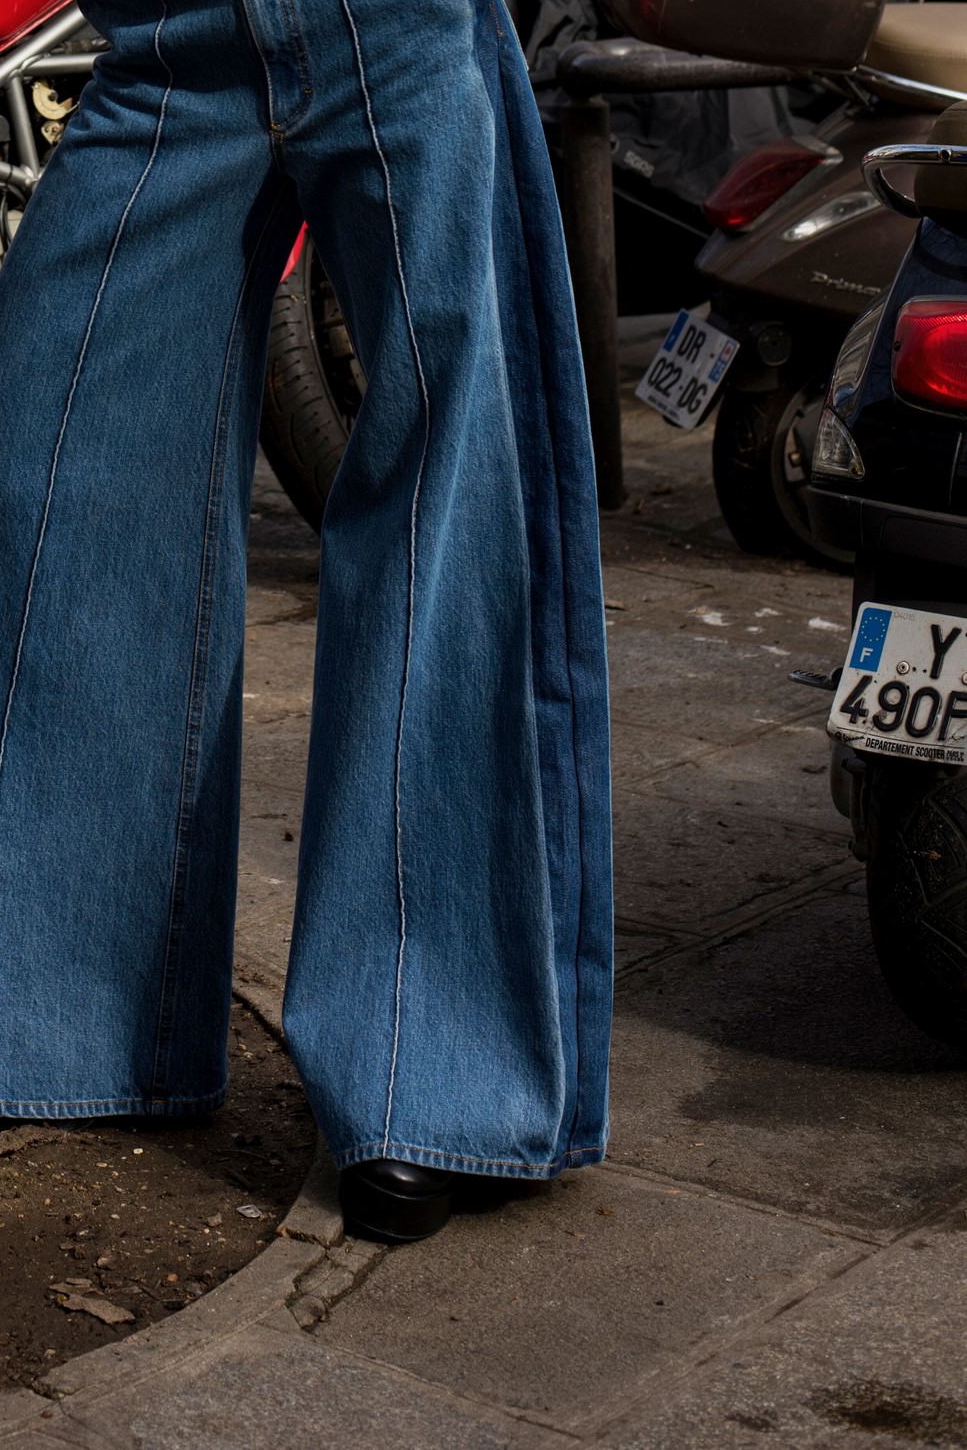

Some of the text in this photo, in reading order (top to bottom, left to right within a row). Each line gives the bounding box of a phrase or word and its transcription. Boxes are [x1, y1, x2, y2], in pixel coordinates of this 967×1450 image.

[677, 325, 707, 365] DR
[860, 647, 874, 663] F
[865, 737, 916, 756] DEPARTEMENT
[915, 744, 946, 760] SCOOTER
